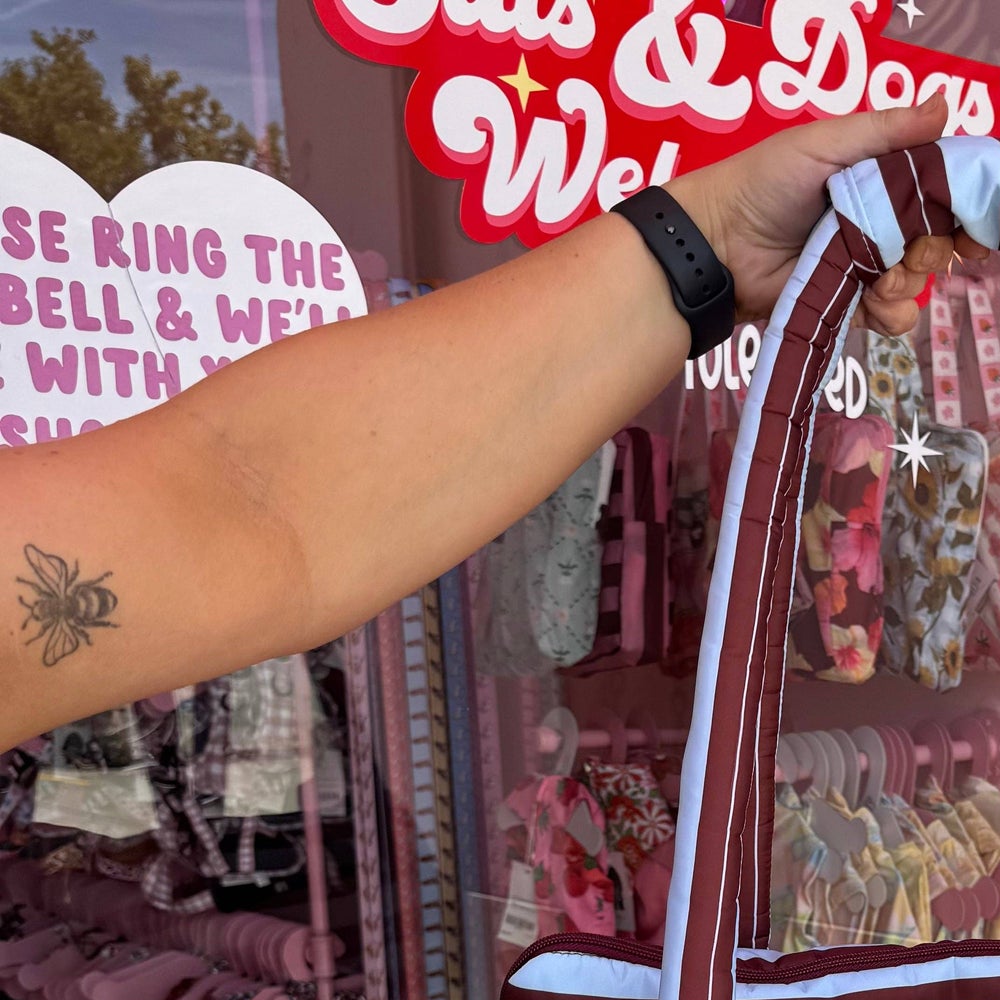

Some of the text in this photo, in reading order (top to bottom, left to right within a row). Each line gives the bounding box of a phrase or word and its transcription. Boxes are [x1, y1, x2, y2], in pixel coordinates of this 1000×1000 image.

[614, 0, 752, 121] &
[758, 0, 996, 137] Dogs
[92, 215, 227, 280] RING
[244, 234, 346, 292] THE
[0, 272, 135, 335] BELL
[155, 286, 198, 342] &
[25, 341, 182, 400] WITH
